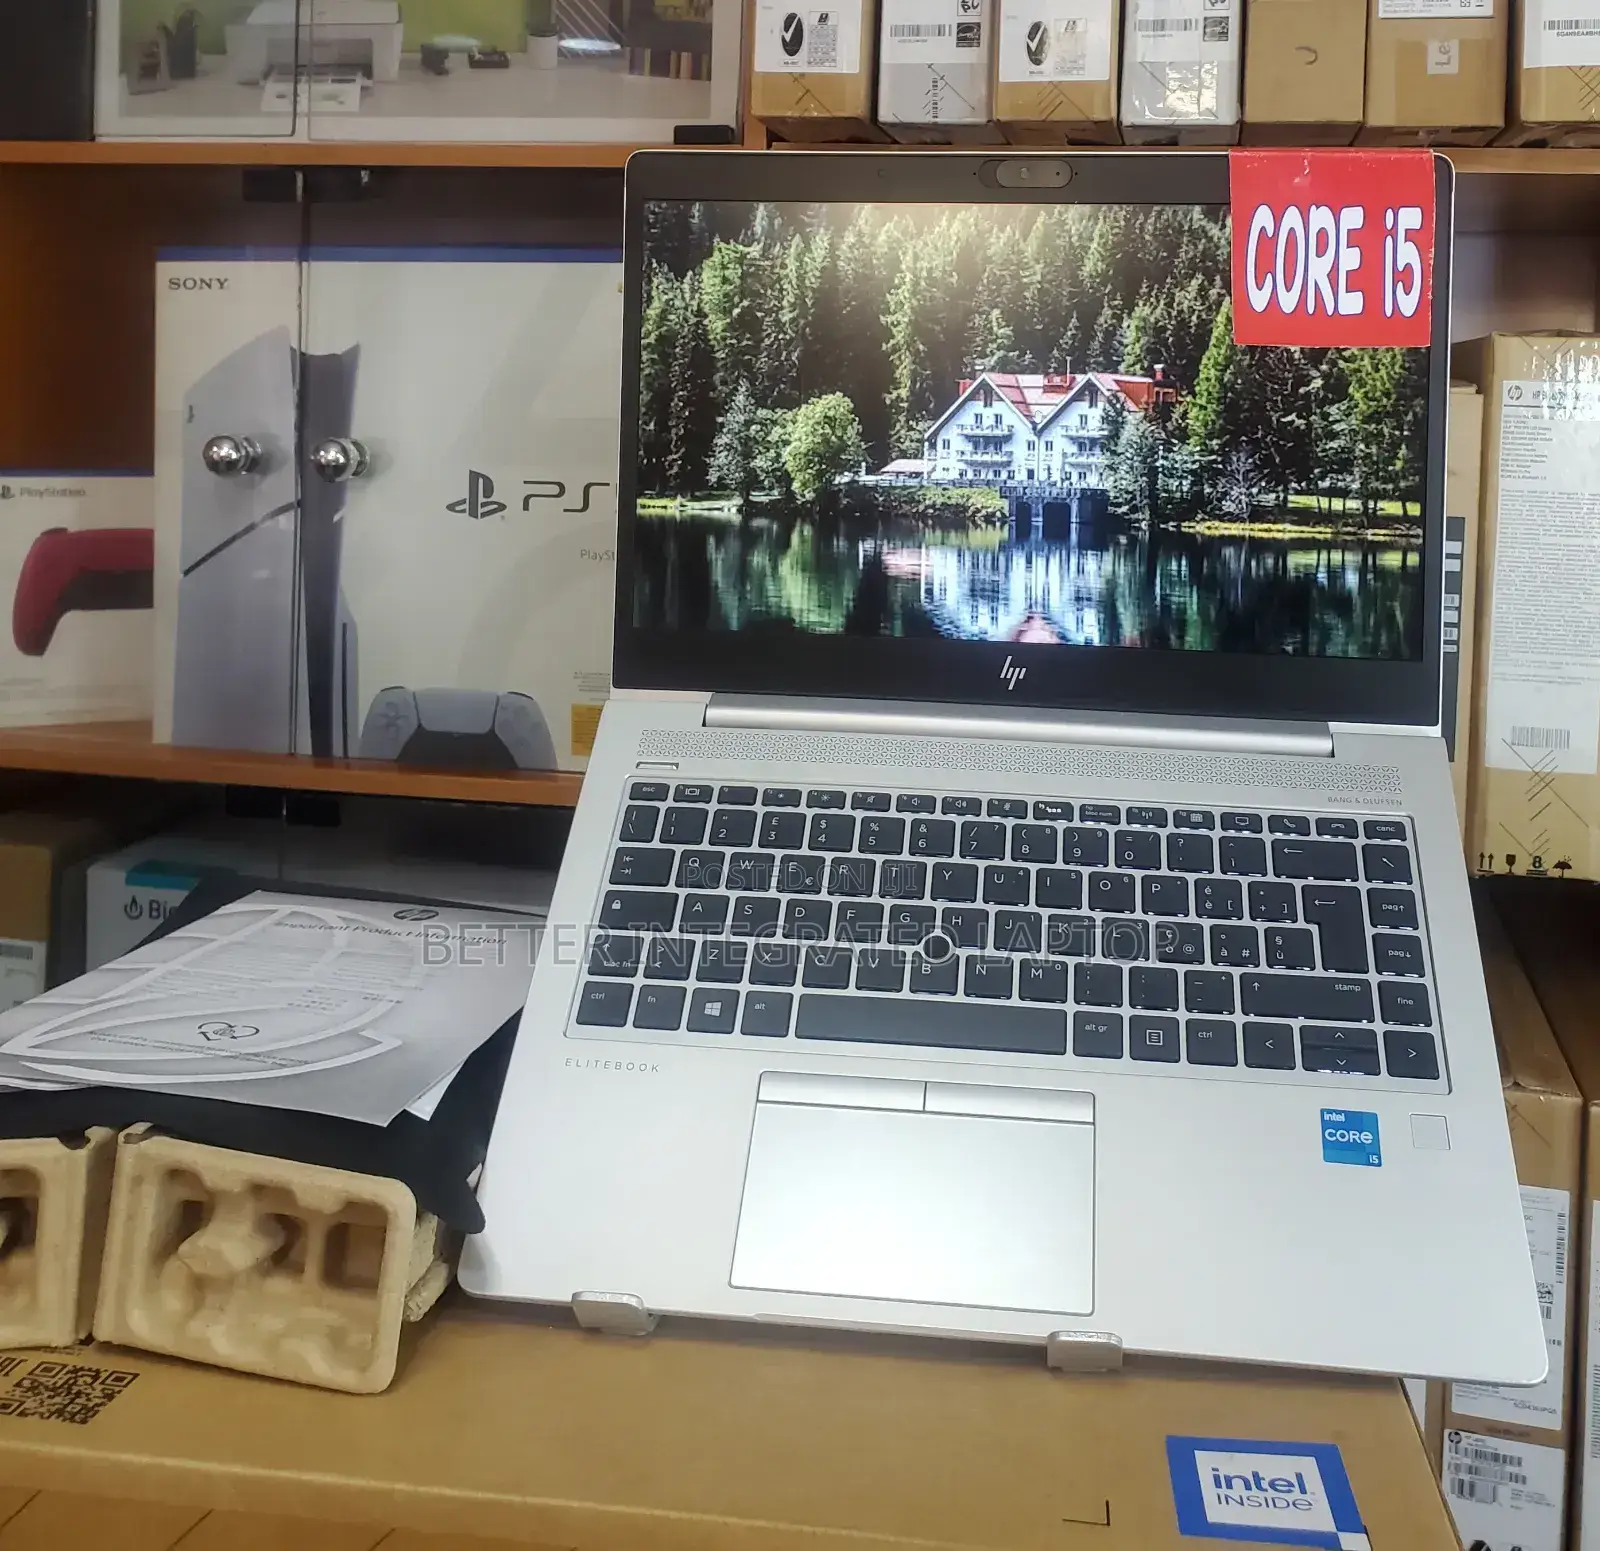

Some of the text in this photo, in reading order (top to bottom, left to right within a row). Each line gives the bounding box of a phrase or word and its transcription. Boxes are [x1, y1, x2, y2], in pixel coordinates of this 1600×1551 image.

[1245, 203, 1423, 318] CORE i5
[168, 277, 229, 290] SONY
[522, 480, 618, 513] PS
[1327, 796, 1352, 804] BANG
[1362, 797, 1403, 806] OLUFSEN
[771, 817, 780, 826] £
[819, 819, 827, 829] $
[670, 826, 675, 836] 1
[869, 822, 880, 832] %
[919, 823, 928, 833] &
[1375, 825, 1396, 833] canc
[718, 829, 727, 838] 2
[767, 831, 777, 840] 3
[817, 834, 827, 843] 4
[867, 836, 876, 846] 5
[918, 838, 927, 848] 6
[969, 841, 977, 850] 7
[1021, 844, 1030, 854] 8
[1072, 847, 1082, 858] 9
[688, 857, 700, 868] Q
[739, 860, 754, 870] W
[788, 862, 798, 872] E
[1532, 855, 1542, 869] 8
[839, 865, 848, 875] R
[891, 867, 899, 878] T
[942, 870, 953, 881] Y
[994, 873, 1004, 883] U
[804, 876, 814, 886] €
[1046, 877, 1050, 887] I
[1099, 880, 1111, 890] O
[1151, 883, 1161, 894] P
[692, 902, 703, 912] A
[743, 905, 753, 915] S
[1382, 903, 1399, 912] pag
[795, 907, 805, 918] D
[846, 910, 856, 921] F
[900, 913, 911, 923] G
[952, 916, 962, 926] H
[1004, 919, 1013, 930] J
[1058, 923, 1069, 933] K
[275, 921, 508, 945] Important Product Information
[1112, 926, 1121, 937] L
[1182, 944, 1195, 954] @
[1241, 948, 1251, 958] #
[709, 949, 719, 960] Z
[761, 952, 772, 963] X
[815, 955, 825, 965] C
[868, 957, 879, 968] V
[921, 963, 931, 974] B
[976, 964, 987, 975] N
[1031, 968, 1043, 979] M
[1334, 983, 1361, 993] stamp
[590, 992, 605, 1000] ctrl
[647, 995, 656, 1003] fn
[1397, 996, 1414, 1005] fine
[754, 1002, 766, 1010] alt
[1084, 1023, 1108, 1034] alt gr
[1198, 1030, 1213, 1039] ctrl
[565, 1057, 660, 1073] ELITEBOOK
[1323, 1111, 1346, 1122] intel
[1211, 1466, 1308, 1495] intel
